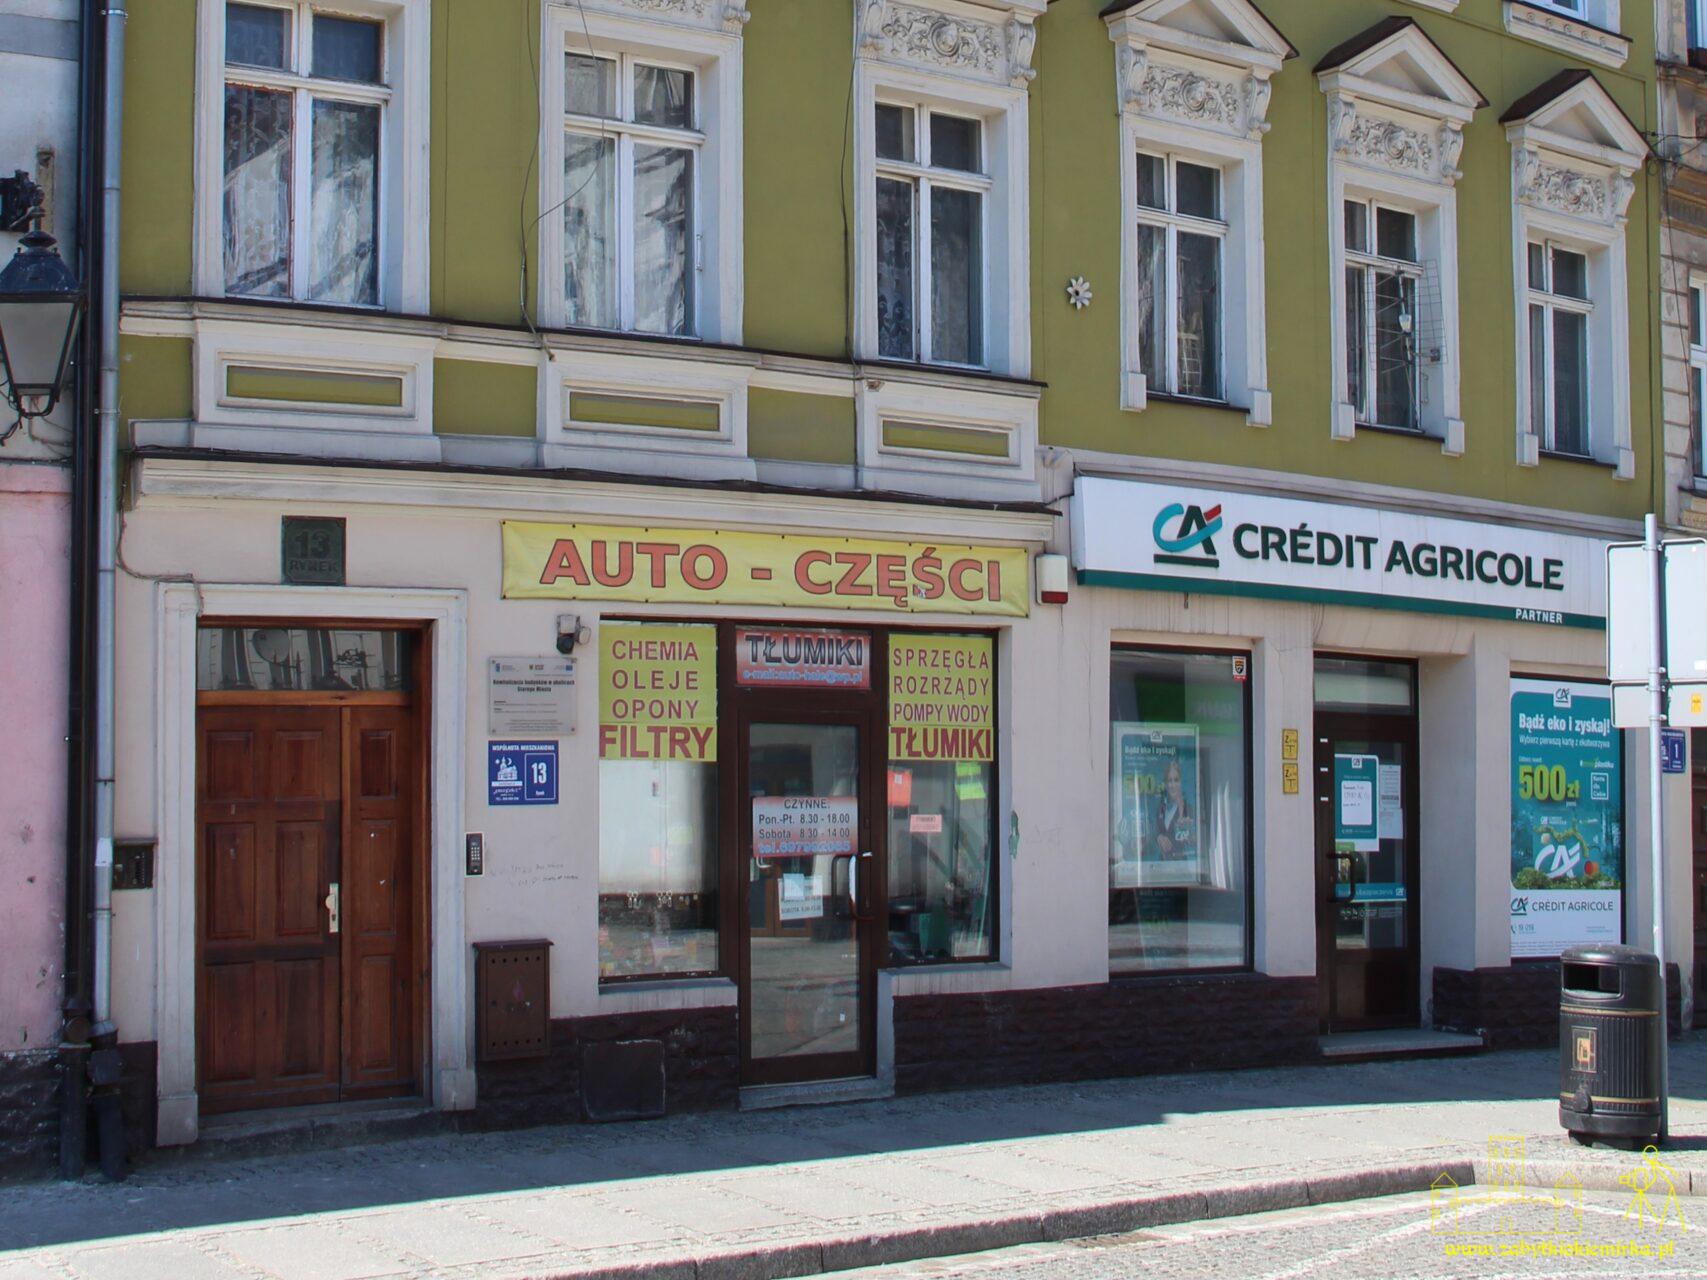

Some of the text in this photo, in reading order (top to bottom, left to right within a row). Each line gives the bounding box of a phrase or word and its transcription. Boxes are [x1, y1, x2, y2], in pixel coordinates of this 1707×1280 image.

[294, 528, 333, 559] 13
[289, 560, 339, 574] RYNEK
[1232, 522, 1565, 592] CRÉDIT AGRICOLE
[539, 538, 1001, 607] AUTO - CZĘŚCI
[1515, 608, 1563, 625] PARTNER
[611, 639, 699, 661] CHEMIA
[745, 634, 863, 666] TŁUMIKI
[893, 648, 989, 673] SPRZĘGŁA
[611, 669, 699, 690] OLEJE
[893, 676, 989, 700] ROZRZĄDY
[611, 699, 699, 719] OPONY
[894, 703, 989, 723] POMPY WODY
[1547, 715, 1567, 731] eko
[1568, 716, 1573, 731] i
[1575, 717, 1610, 737] zyskaj!
[600, 724, 714, 759] FILTRY
[890, 727, 991, 759] TŁUMIKI
[531, 762, 547, 785] 13
[1518, 763, 1580, 801] 500 zł
[800, 813, 819, 824] 8.30
[827, 812, 850, 824] 18.00
[758, 828, 791, 840] Sobota
[1531, 899, 1614, 912] CRÉDIT AGRICOLE
